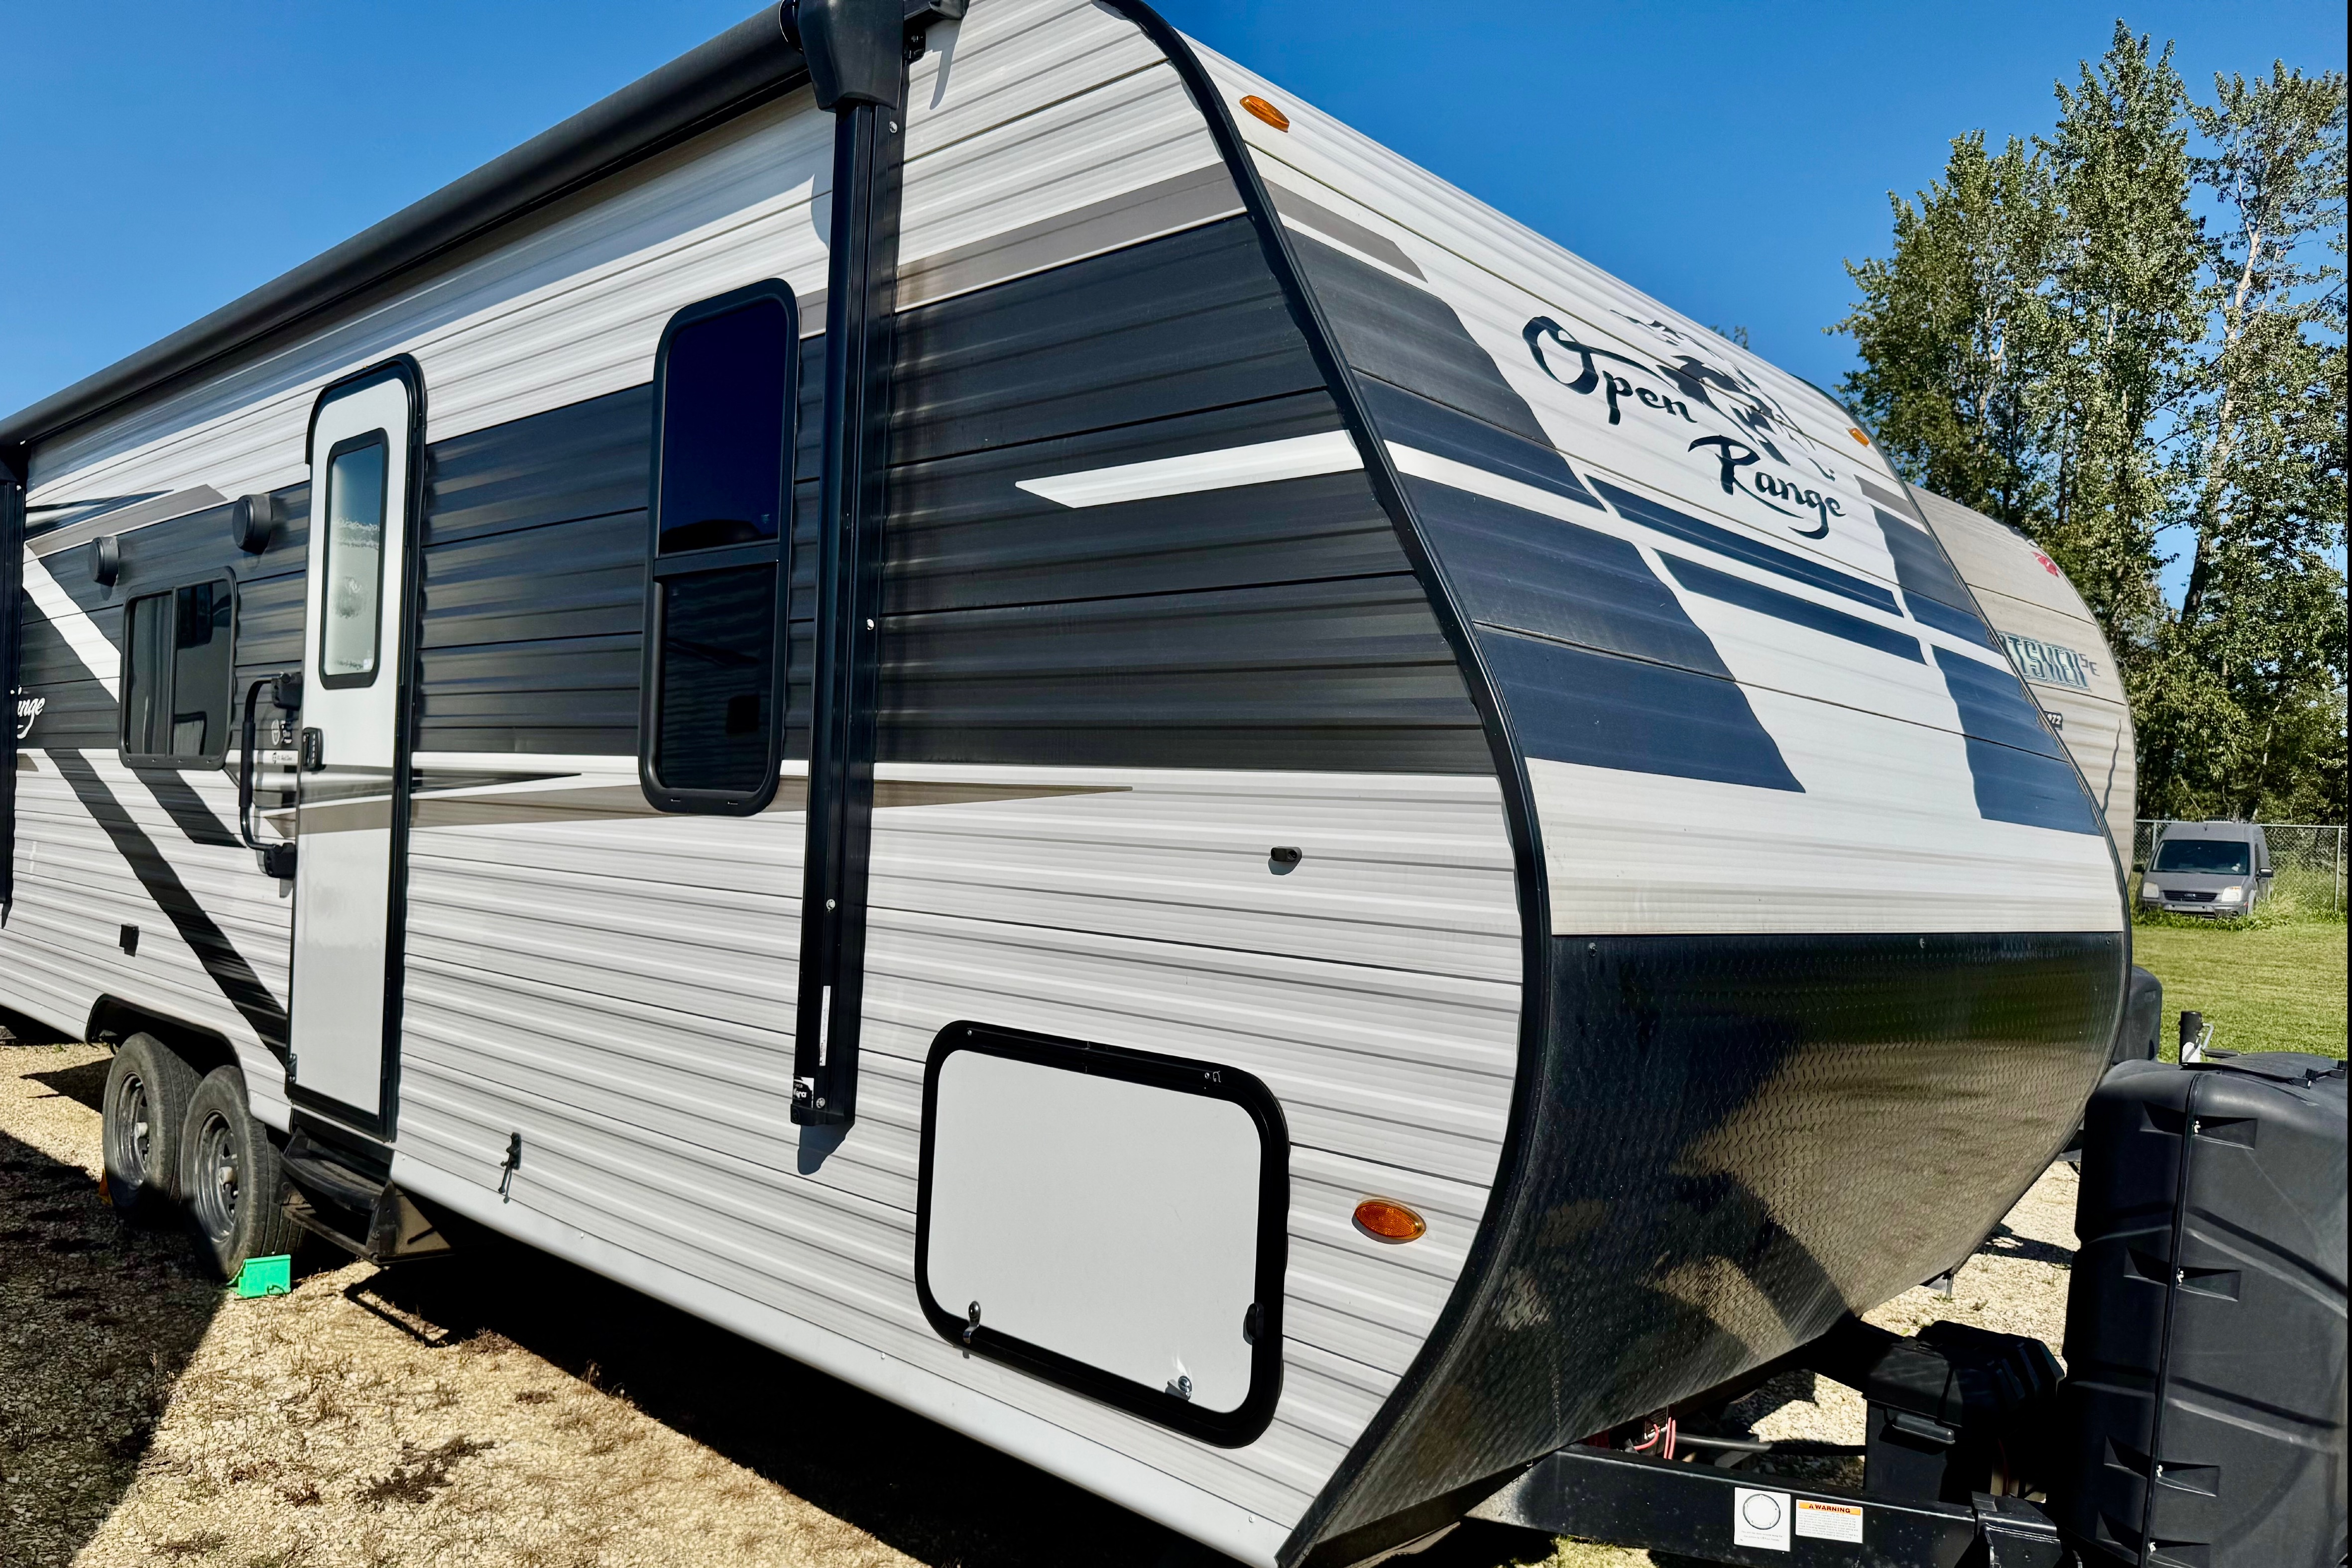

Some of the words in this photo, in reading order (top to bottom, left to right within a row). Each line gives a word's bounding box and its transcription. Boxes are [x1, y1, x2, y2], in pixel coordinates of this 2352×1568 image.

[1522, 316, 1697, 426] Open
[1688, 435, 1846, 540] Range
[1996, 630, 2090, 690] TSMEN
[16, 687, 45, 739] ange
[1815, 1504, 1851, 1513] WARNING
